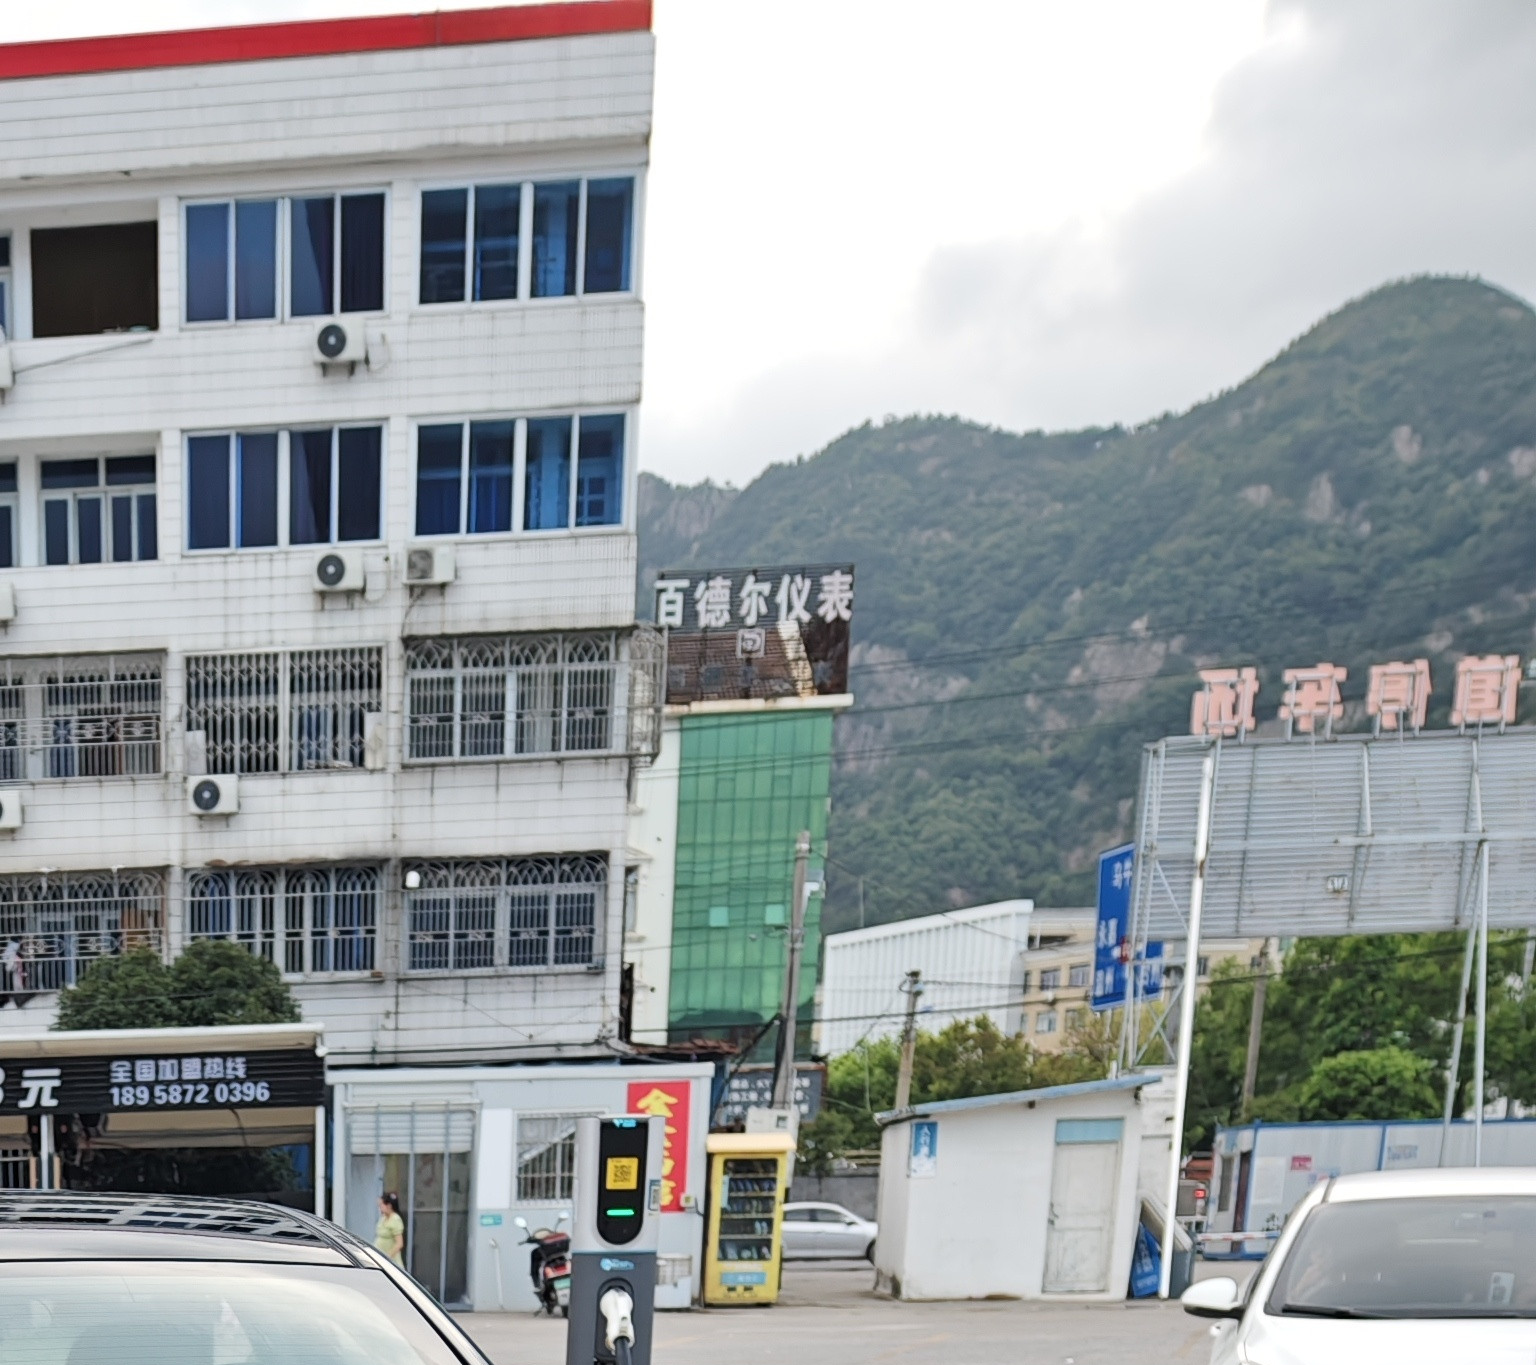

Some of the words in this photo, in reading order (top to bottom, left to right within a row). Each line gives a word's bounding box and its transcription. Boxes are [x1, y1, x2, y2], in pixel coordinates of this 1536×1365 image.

[654, 570, 854, 629] 百德尔仪表
[109, 1057, 247, 1083] 全国加盟热线
